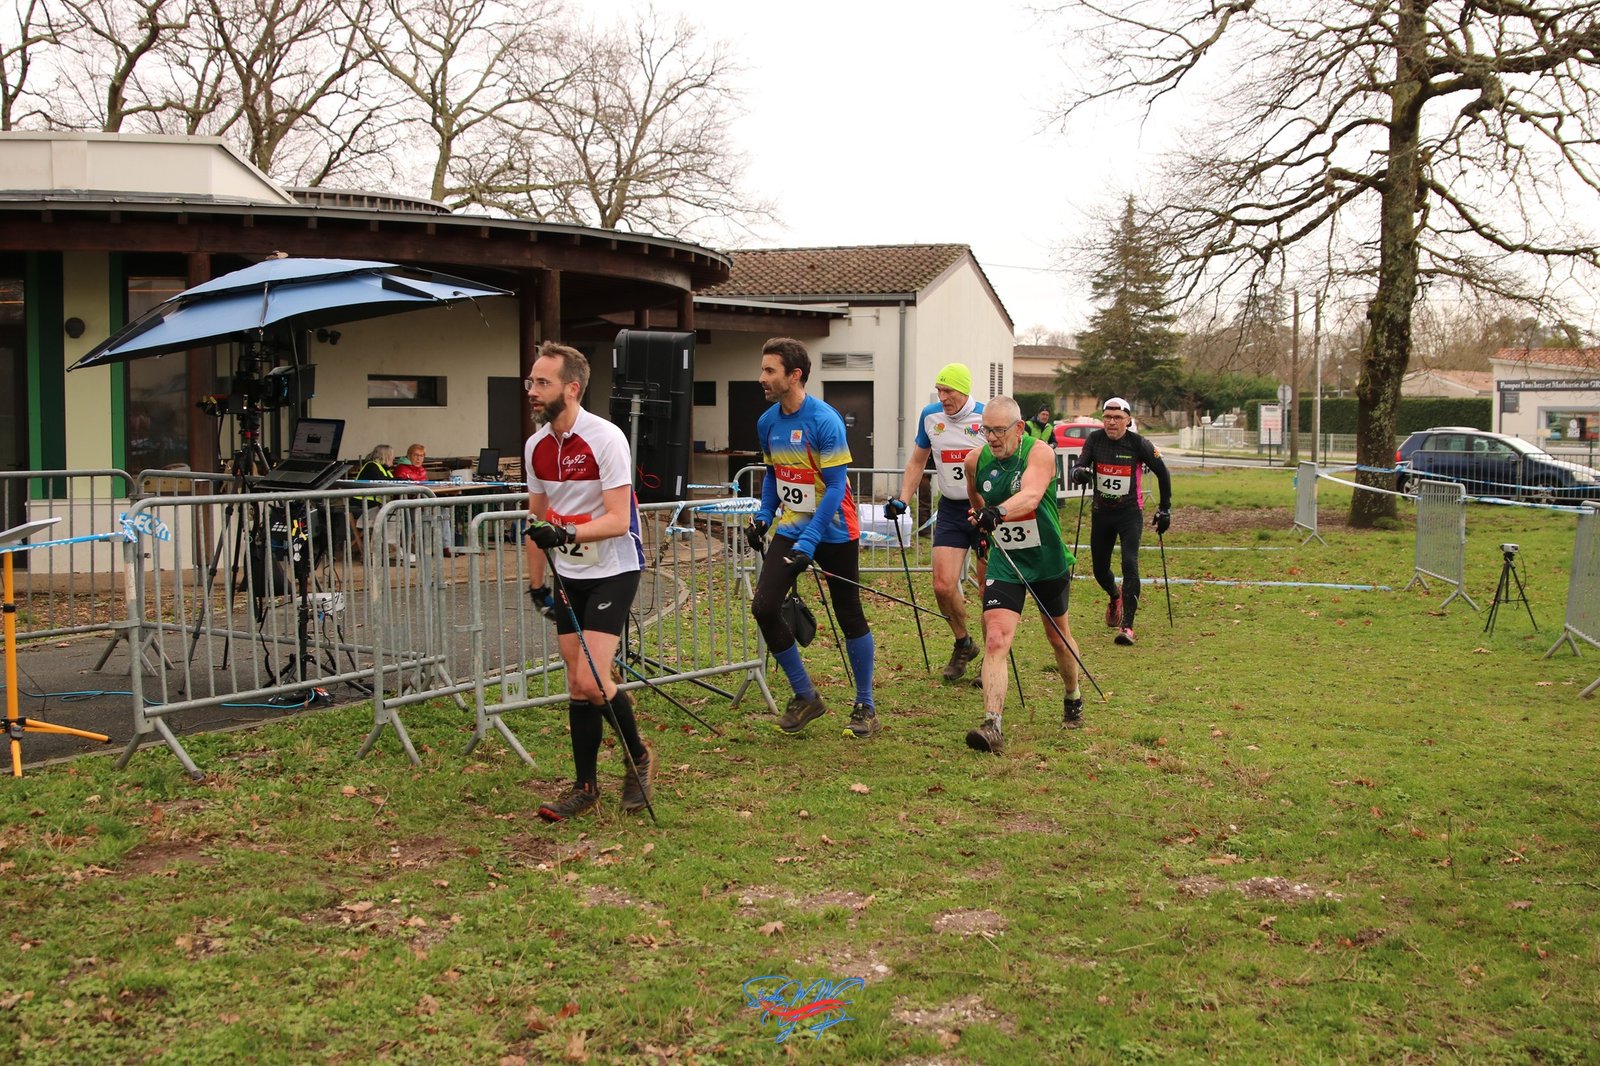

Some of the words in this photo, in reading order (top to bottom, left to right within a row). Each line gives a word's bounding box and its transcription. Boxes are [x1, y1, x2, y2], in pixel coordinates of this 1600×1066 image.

[1102, 478, 1122, 490] 45
[782, 486, 803, 504] 29
[1000, 526, 1026, 542] 33
